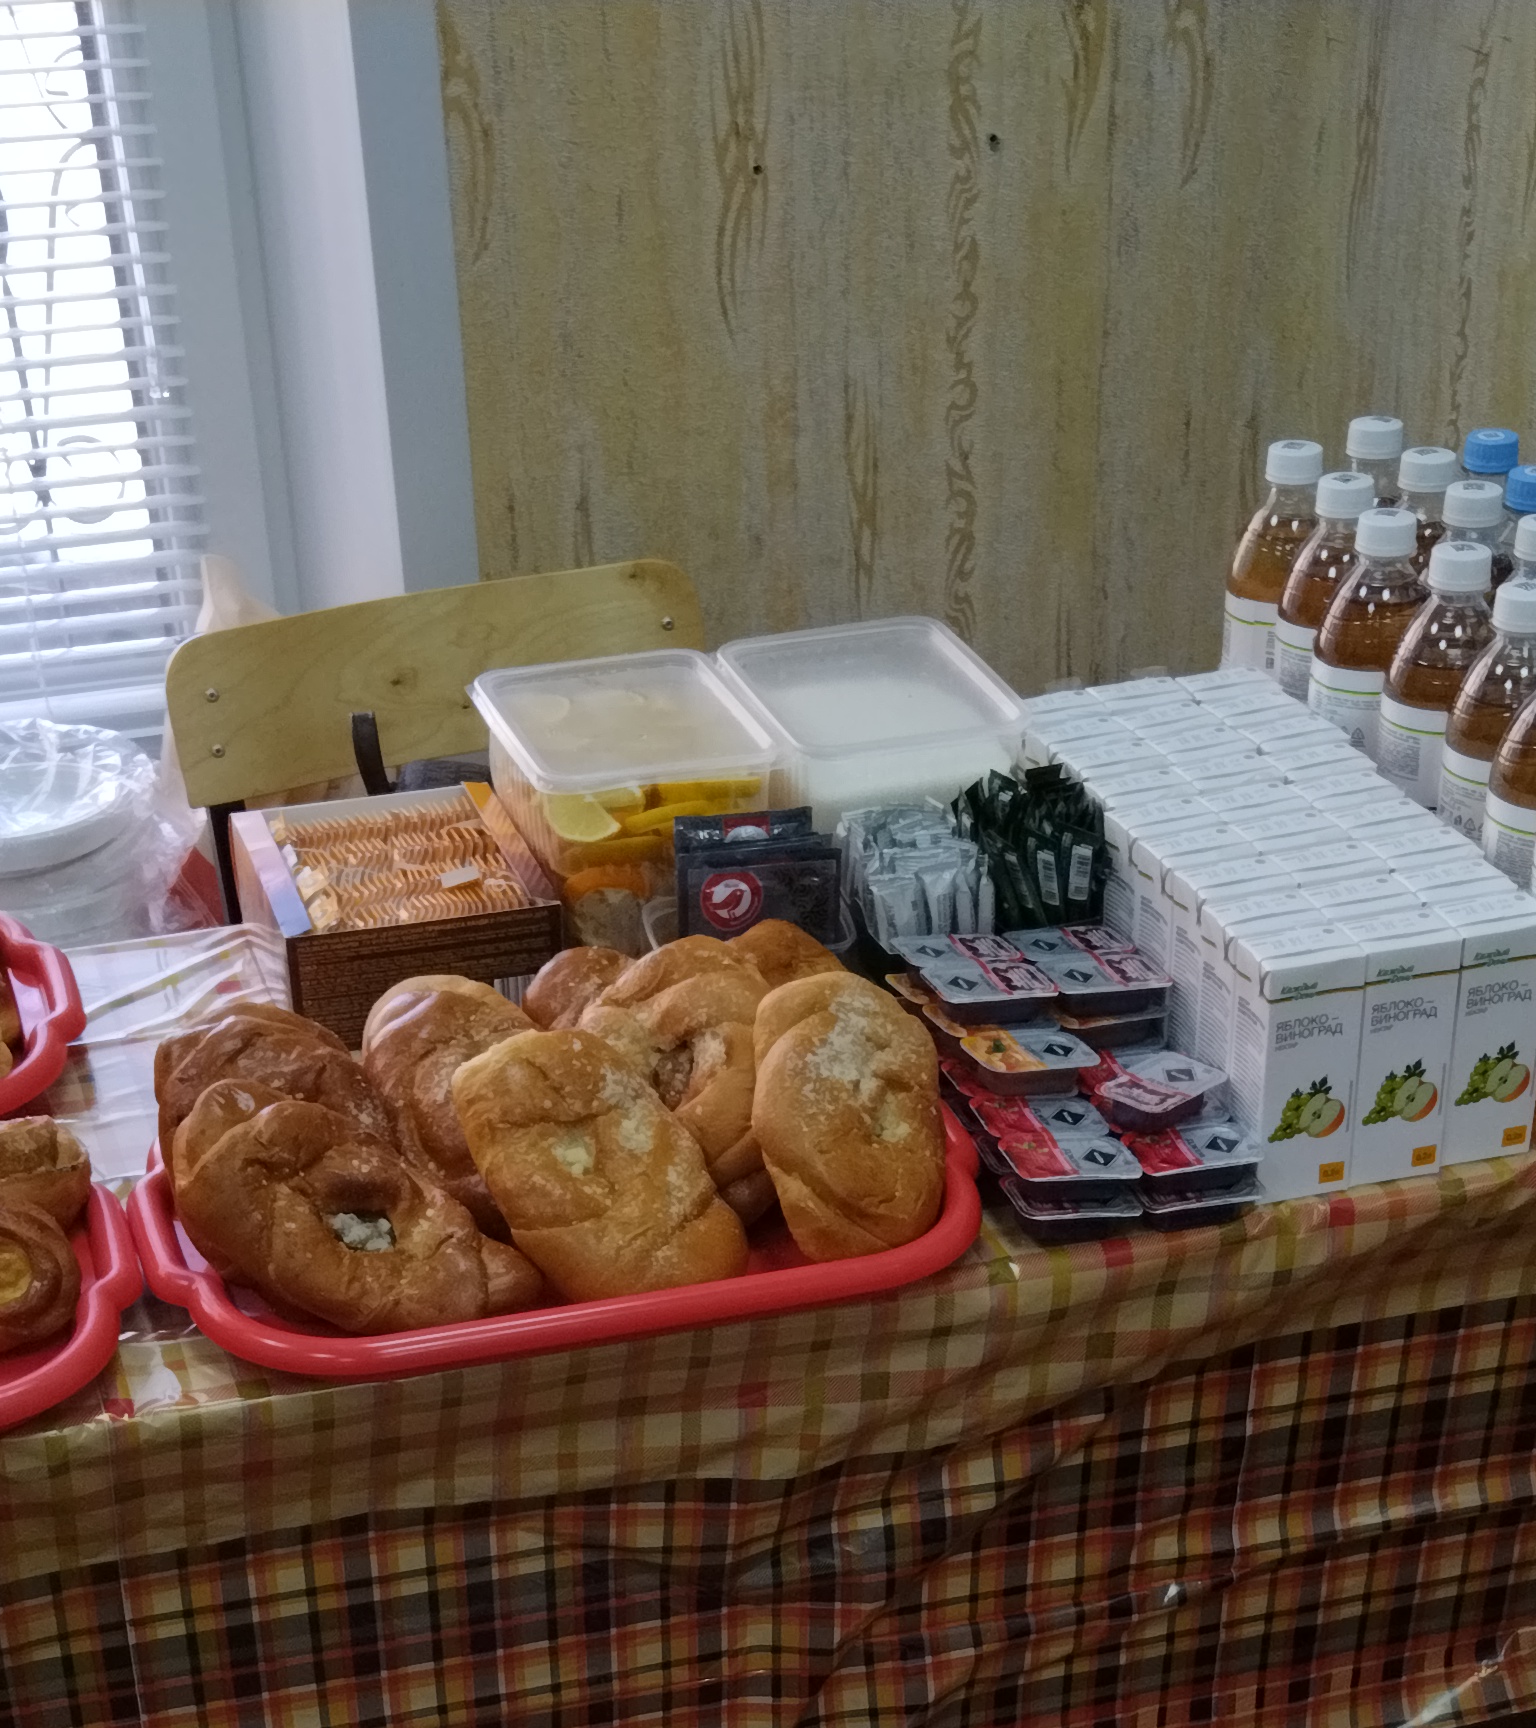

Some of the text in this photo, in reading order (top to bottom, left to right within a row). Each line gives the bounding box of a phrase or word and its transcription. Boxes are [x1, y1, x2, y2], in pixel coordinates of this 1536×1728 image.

[1466, 989, 1532, 1010] ВИНОГРАД
[1370, 1007, 1438, 1027] ВИНОГРАД
[1275, 1023, 1343, 1045] ВИНОГРАД
